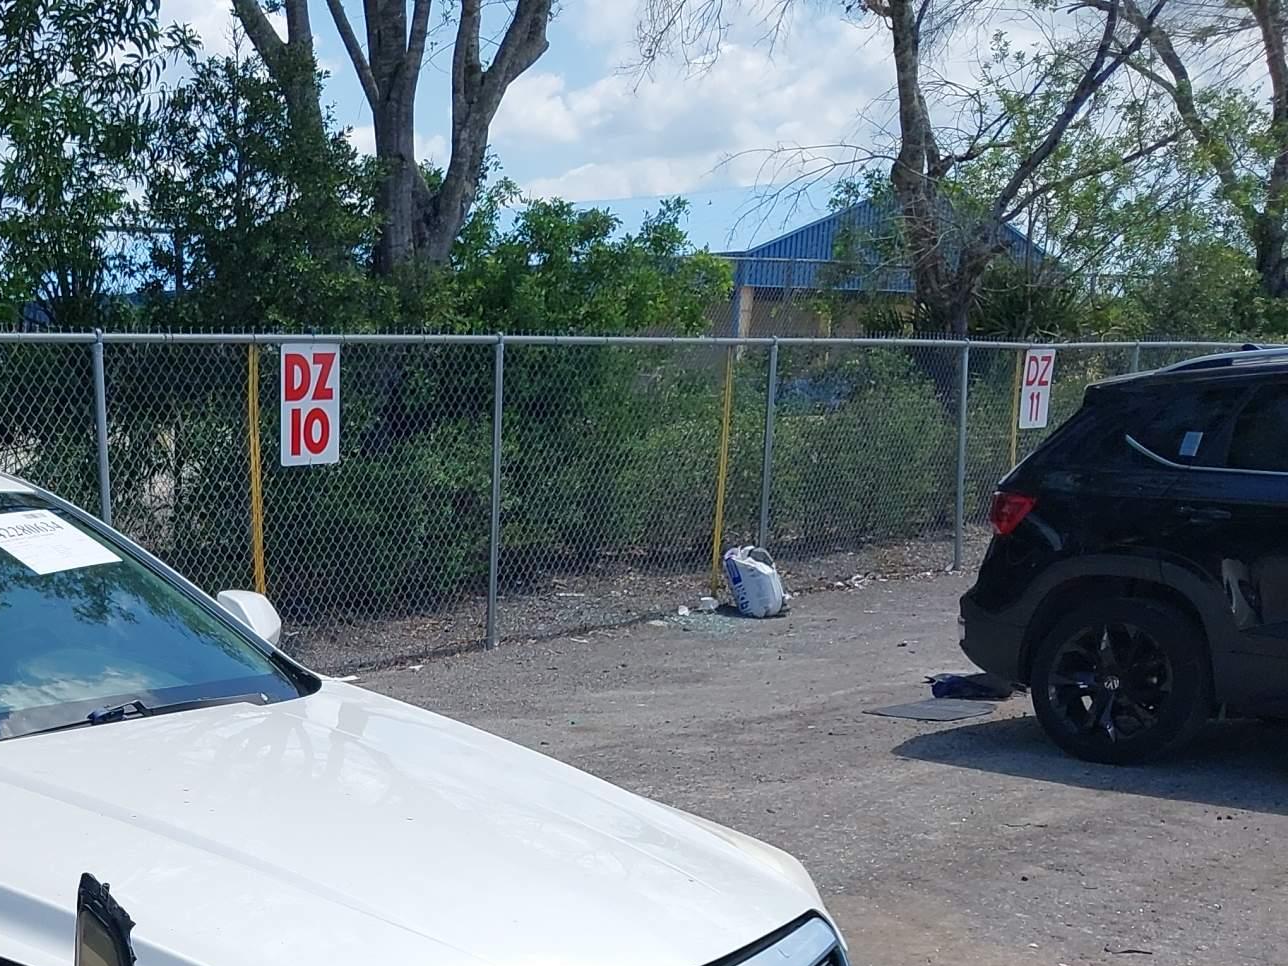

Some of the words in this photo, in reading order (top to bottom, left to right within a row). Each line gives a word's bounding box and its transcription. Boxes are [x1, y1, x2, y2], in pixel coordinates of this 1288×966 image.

[285, 353, 336, 401] DZ
[1026, 355, 1052, 386] DZ
[1029, 391, 1040, 421] 11
[291, 408, 330, 456] 10
